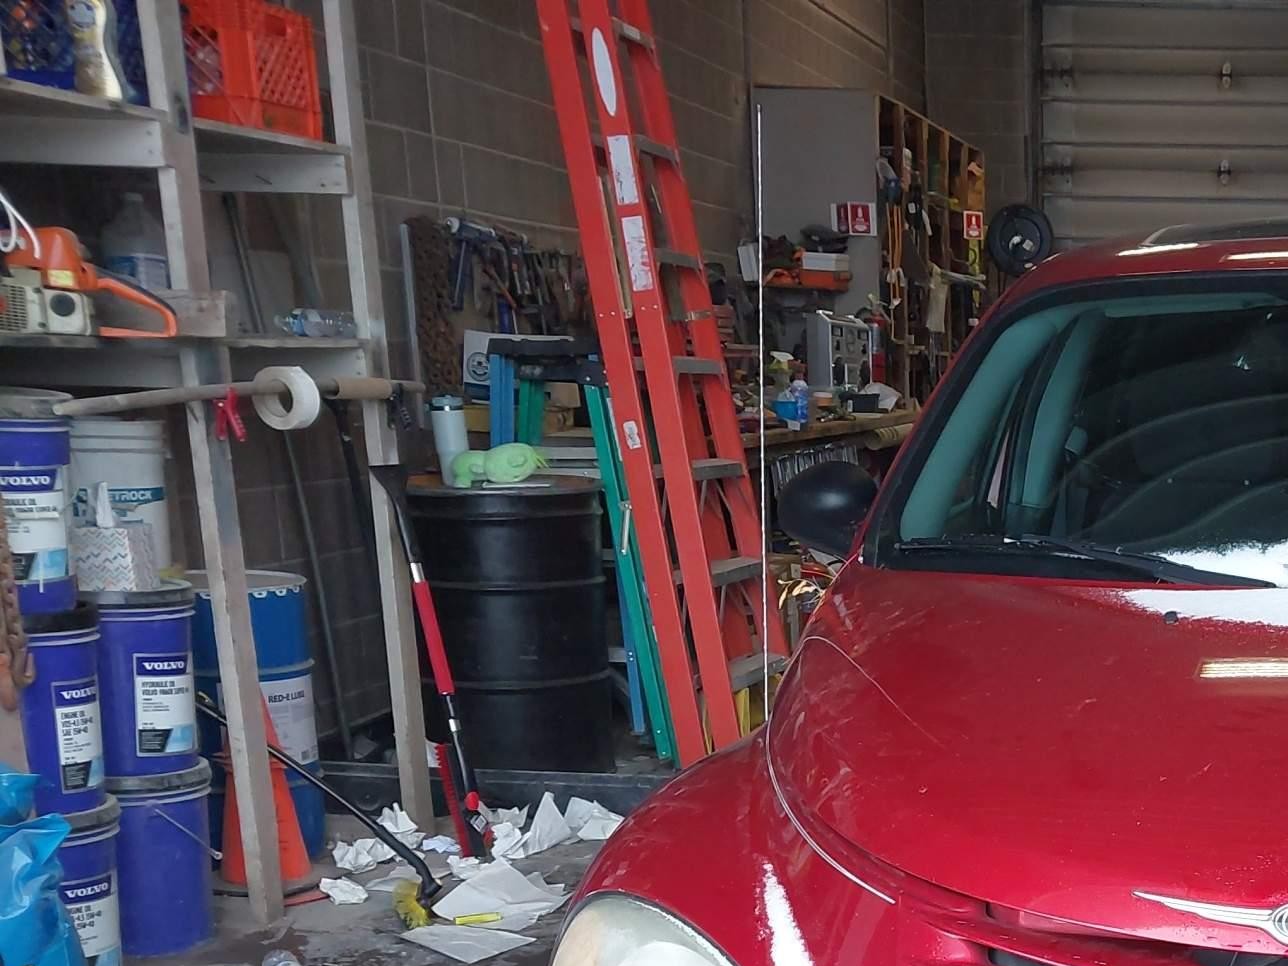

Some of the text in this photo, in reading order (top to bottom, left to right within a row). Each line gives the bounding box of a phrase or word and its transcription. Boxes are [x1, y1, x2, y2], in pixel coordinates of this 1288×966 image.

[0, 475, 51, 486] VOLVO
[142, 661, 185, 671] VOLVO
[64, 882, 109, 899] VOLVO
